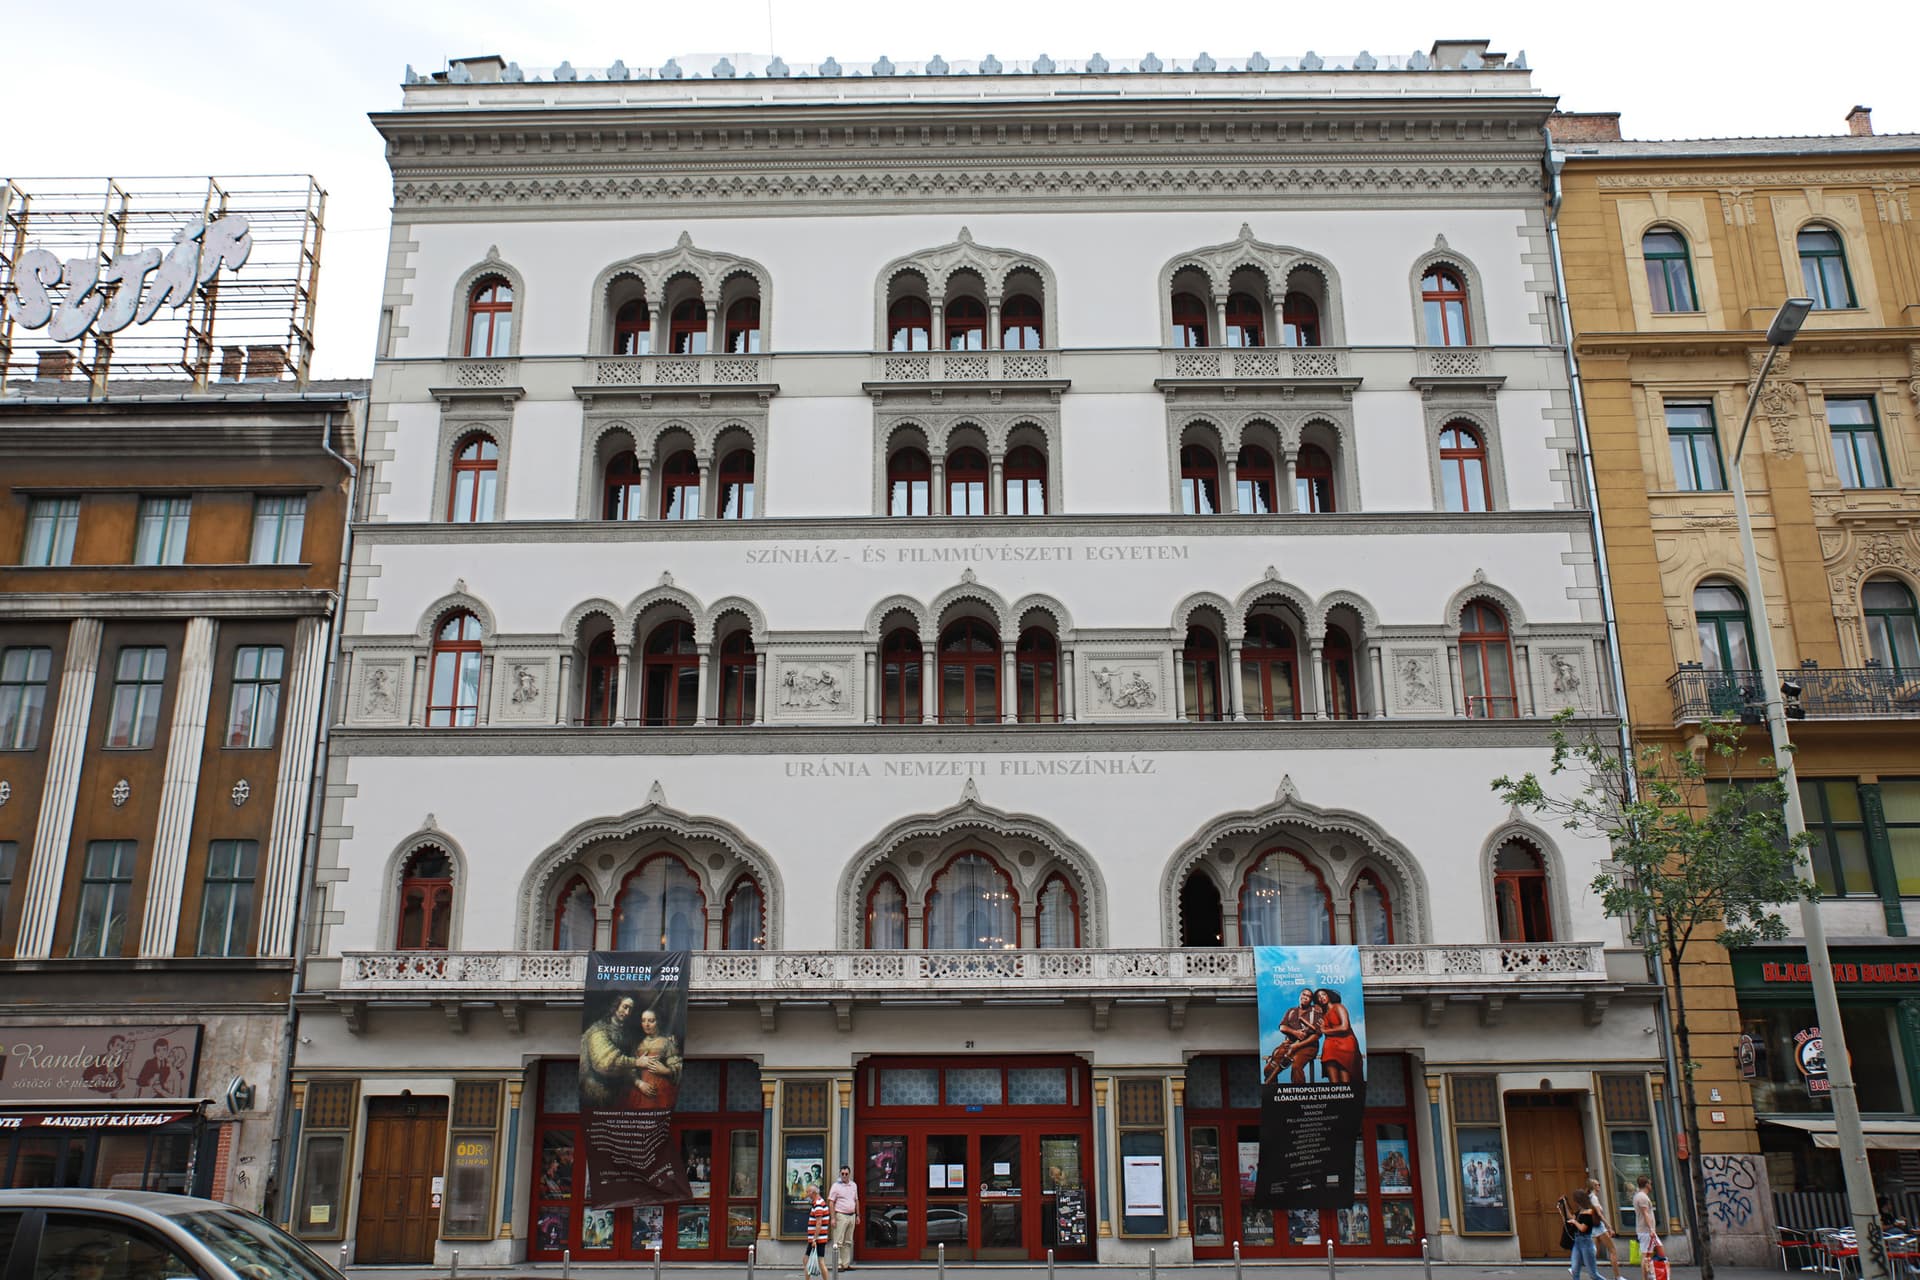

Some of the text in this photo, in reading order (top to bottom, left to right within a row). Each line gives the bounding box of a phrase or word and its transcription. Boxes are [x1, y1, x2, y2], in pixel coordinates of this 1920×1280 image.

[862, 544, 887, 563] ÉS
[1086, 545, 1189, 560] EGYETEM
[785, 756, 1156, 777] URÁNIA NEMZETI FILMSZÍNHÁZ
[597, 965, 680, 974] EXHIBITION 2019
[613, 973, 651, 981] SCREEN
[660, 974, 679, 982] 2020
[1320, 974, 1346, 985] 2020
[965, 1040, 974, 1049] 21
[12, 1043, 124, 1069] Randevú
[1282, 1086, 1330, 1094] METROPOLITAN
[40, 1115, 107, 1127] RANDEVÚ
[457, 1142, 490, 1156] ÓDRY
